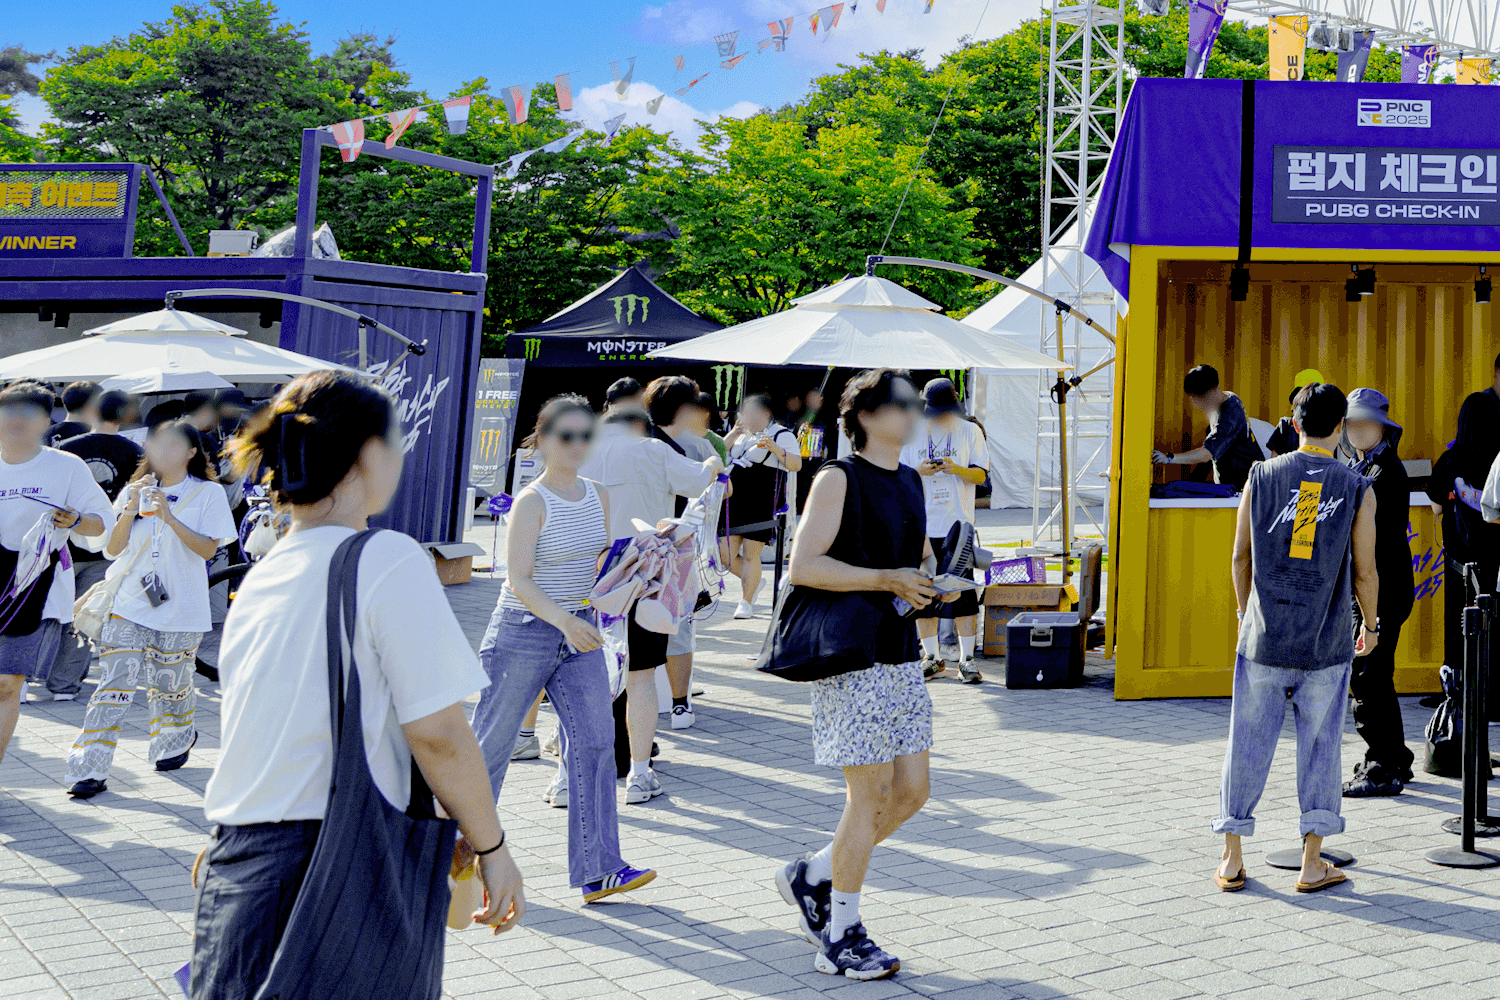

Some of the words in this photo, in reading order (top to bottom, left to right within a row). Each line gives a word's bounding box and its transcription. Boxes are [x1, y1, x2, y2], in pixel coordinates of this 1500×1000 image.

[1386, 102, 1424, 112] PNC
[1386, 114, 1428, 125] 2025
[1287, 152, 1366, 191] 펍지
[1379, 153, 1498, 194] 체크인
[40, 181, 119, 208] 이벤트
[1305, 203, 1369, 217] PUBG
[1375, 204, 1480, 219] CHECK-IN
[587, 339, 667, 354] MONSTER
[485, 391, 518, 400] FREE
